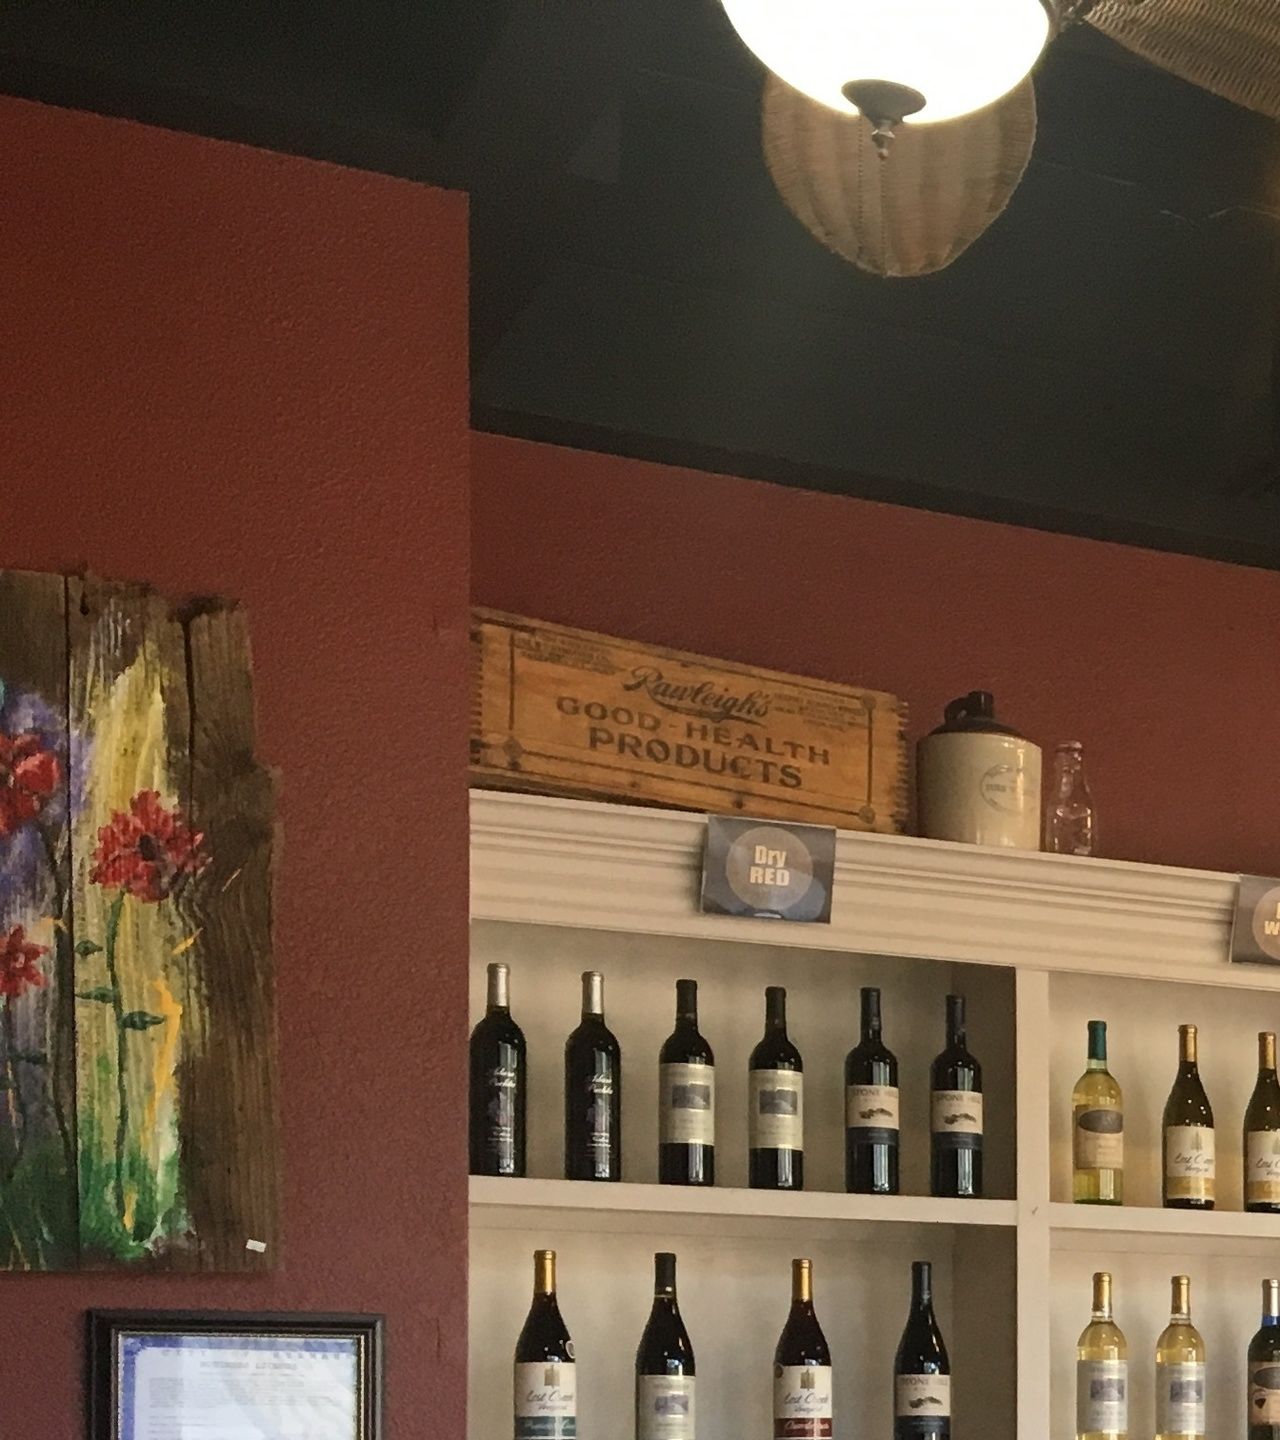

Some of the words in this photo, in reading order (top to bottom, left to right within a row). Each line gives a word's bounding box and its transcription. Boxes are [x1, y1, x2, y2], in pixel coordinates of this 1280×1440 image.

[589, 727, 803, 788] PRODUCTS
[754, 845, 787, 868] Dry
[750, 866, 790, 886] RED
